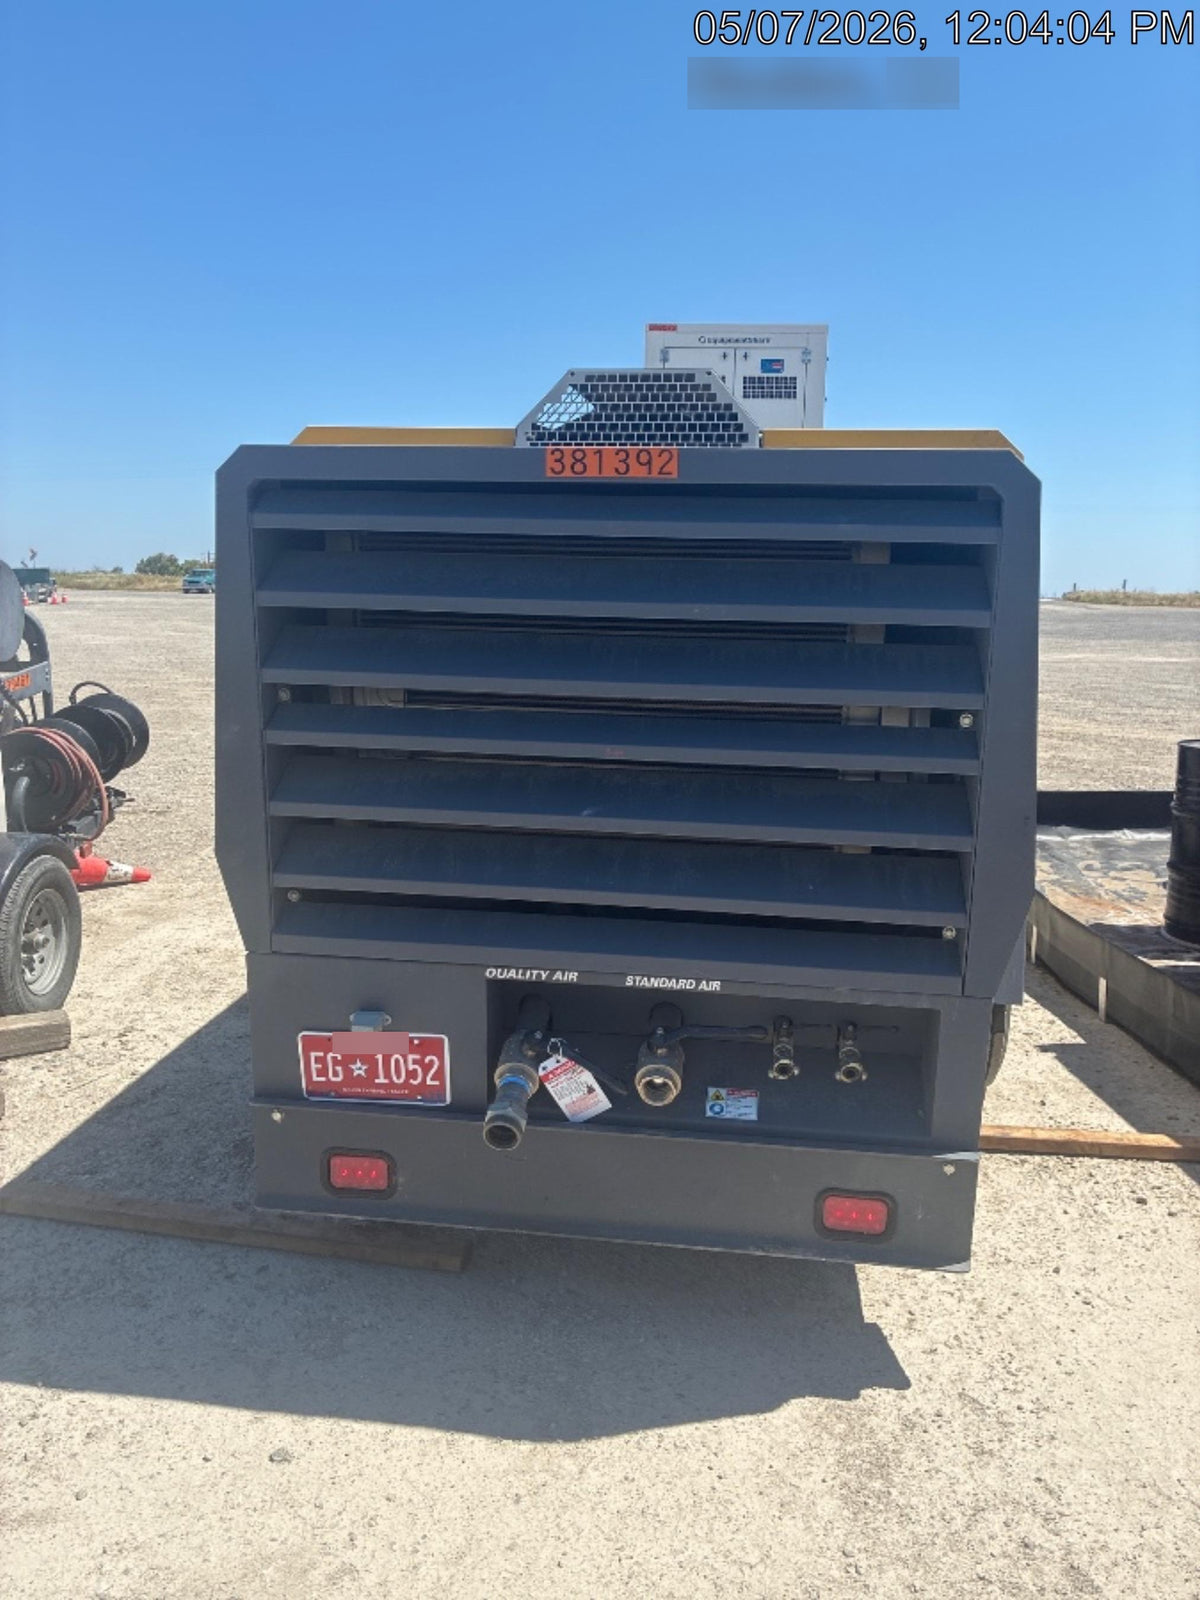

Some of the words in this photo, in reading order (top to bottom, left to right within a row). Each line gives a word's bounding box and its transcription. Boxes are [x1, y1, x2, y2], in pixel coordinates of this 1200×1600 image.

[549, 448, 674, 476] 381392
[485, 967, 550, 981] QUALITY
[552, 970, 579, 982] AIR
[625, 975, 697, 991] STANDARD
[698, 979, 722, 992] AIR
[309, 1051, 344, 1083] EG
[374, 1053, 440, 1086] 1052
